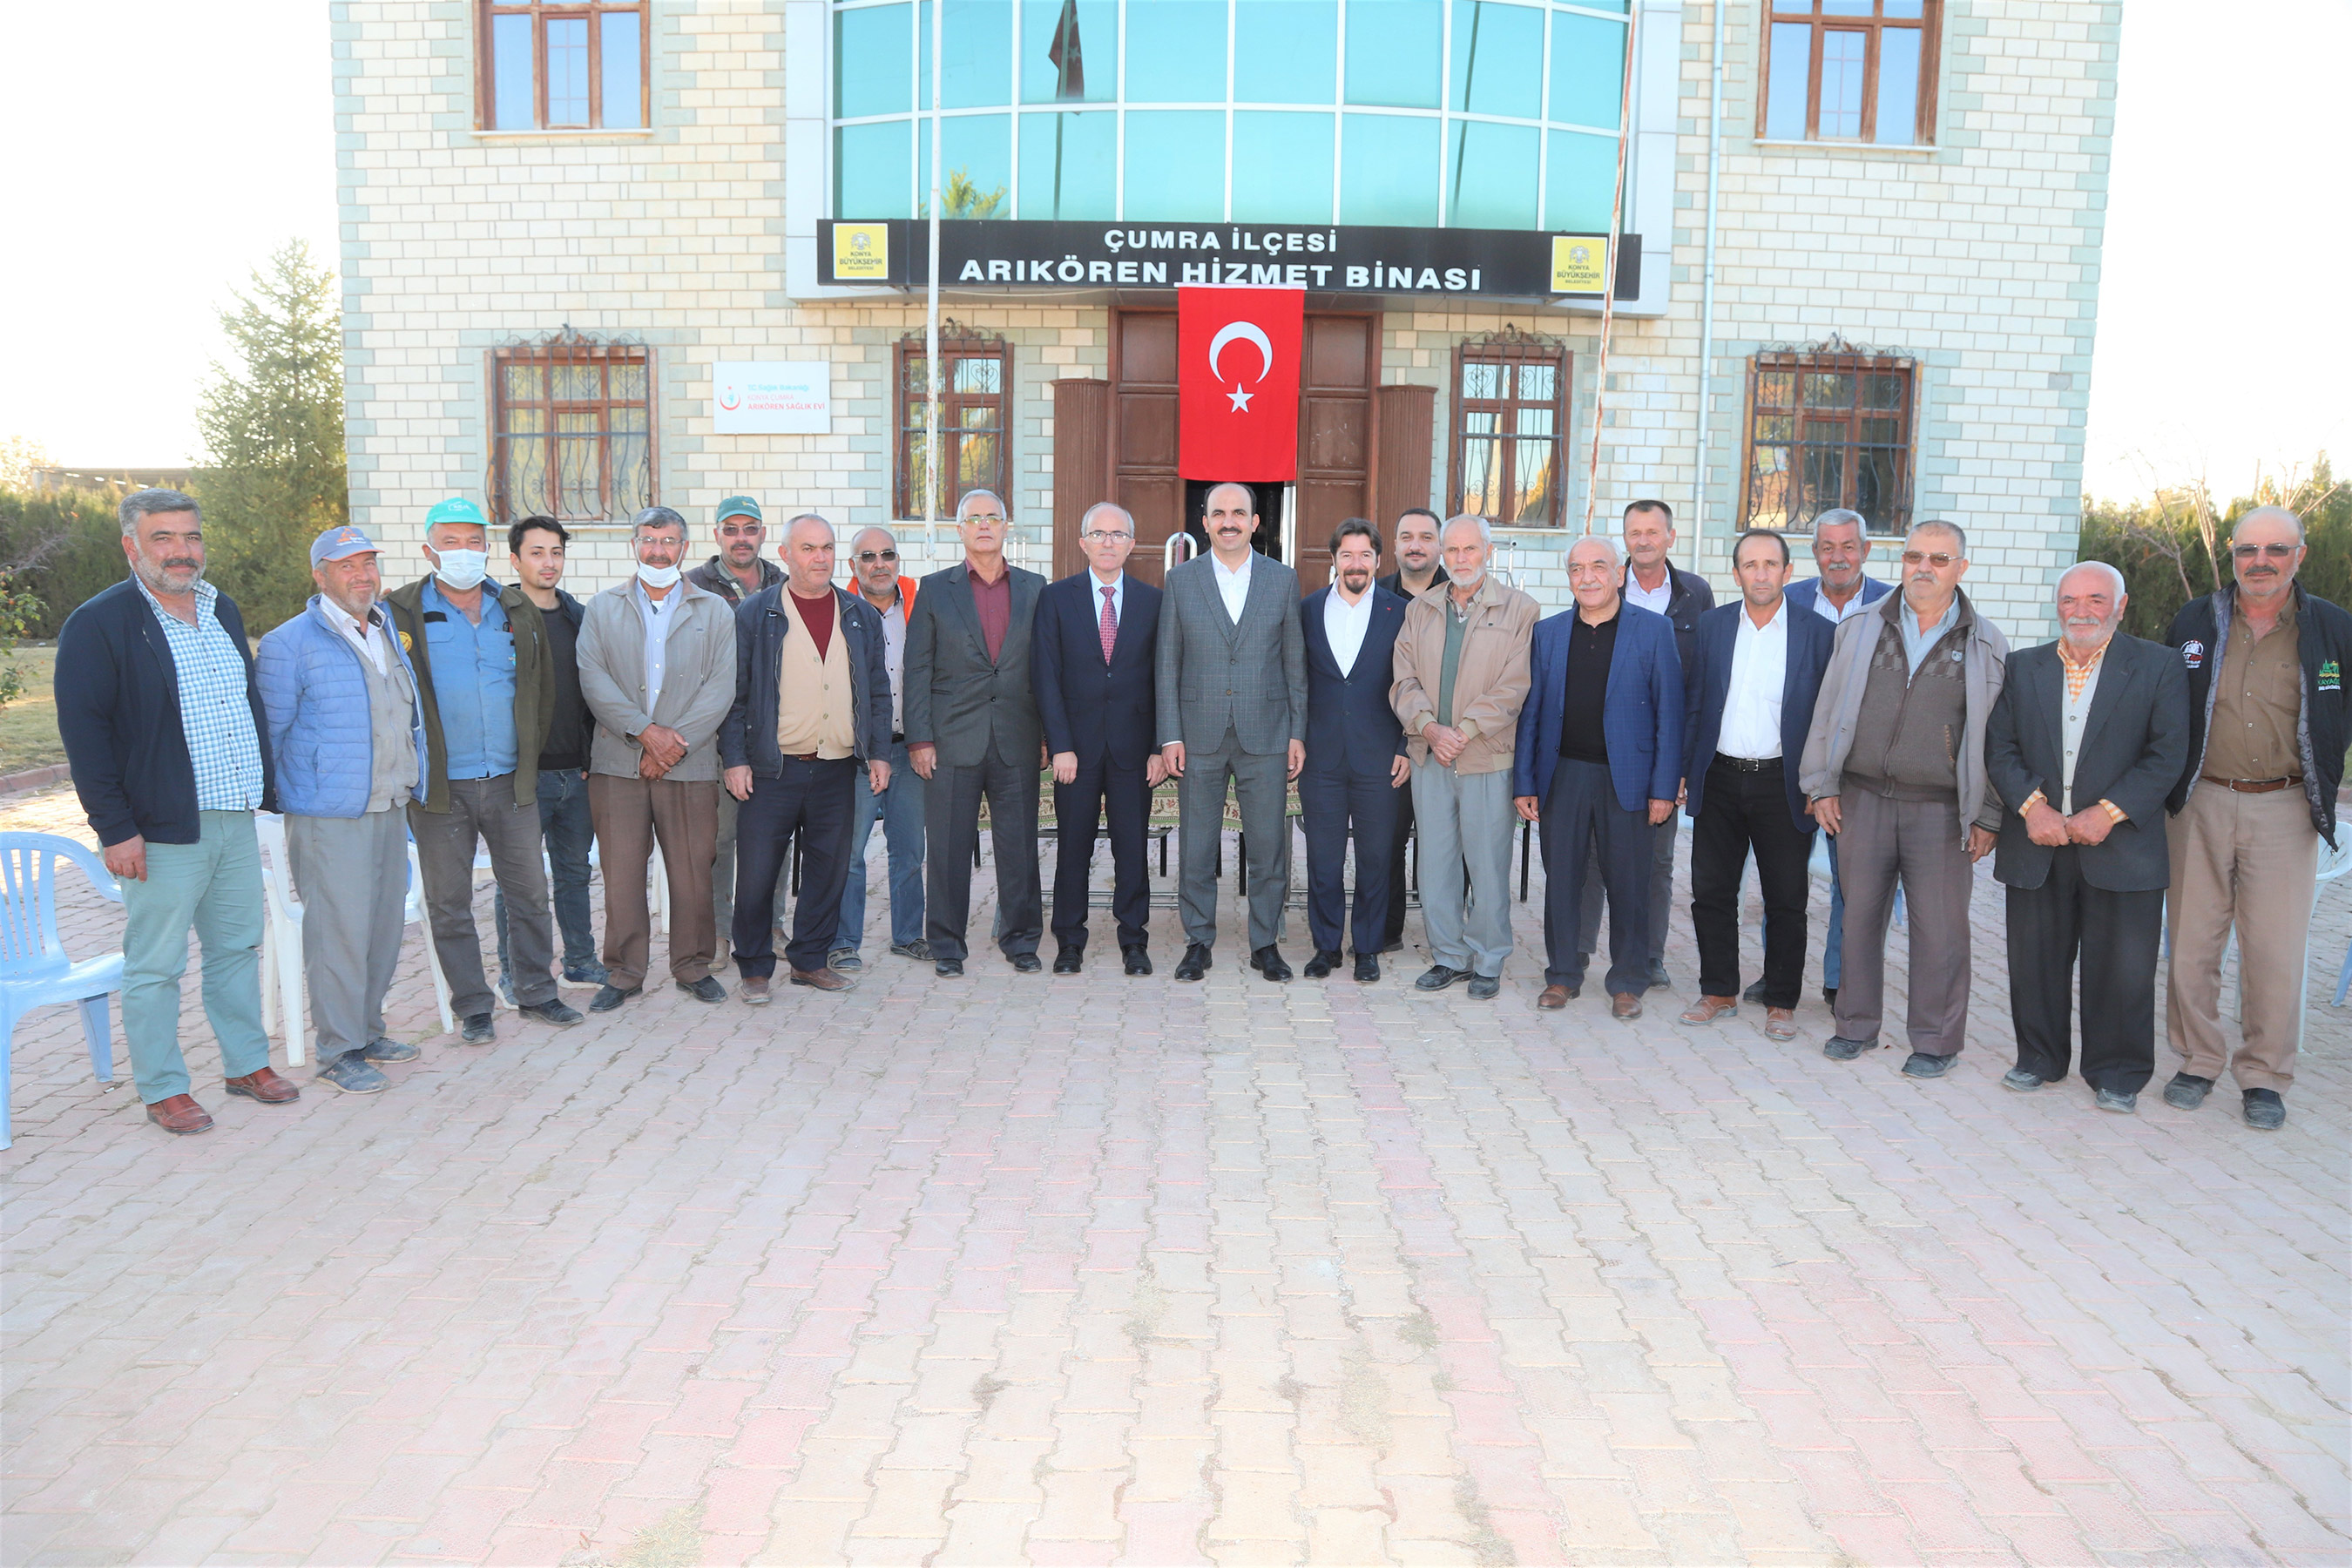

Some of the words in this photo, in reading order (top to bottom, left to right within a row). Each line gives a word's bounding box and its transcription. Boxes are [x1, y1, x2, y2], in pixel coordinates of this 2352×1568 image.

[1104, 229, 1221, 253] ÇUMRA
[1232, 226, 1336, 256] İLÇESİ
[839, 256, 882, 265] BÜYÜKŞEHİR
[958, 254, 1167, 283] ARIKÖREN
[1182, 256, 1333, 287] HİZMET
[1346, 260, 1481, 291] BİNASI
[1556, 270, 1600, 279] BÜYÜKŞEHİR
[786, 402, 812, 410] SAĞLIK
